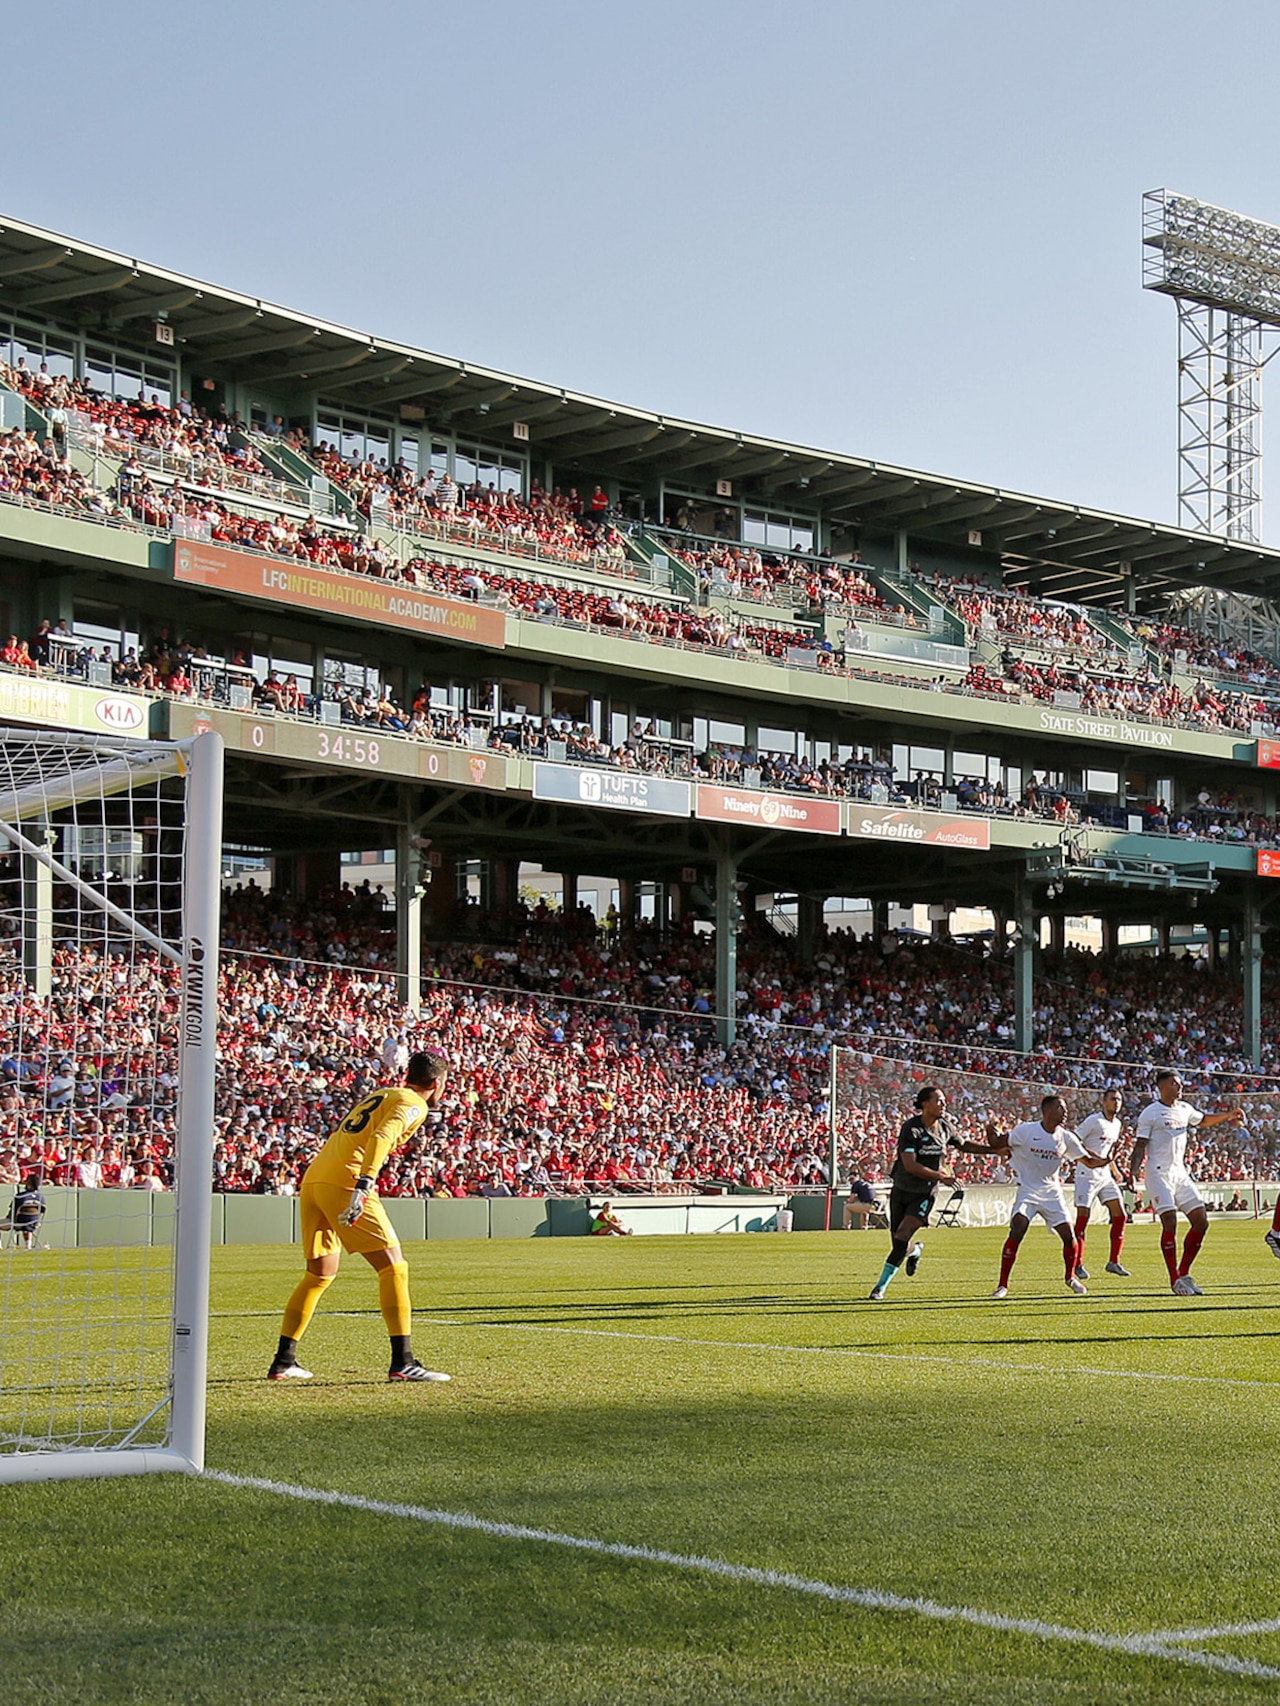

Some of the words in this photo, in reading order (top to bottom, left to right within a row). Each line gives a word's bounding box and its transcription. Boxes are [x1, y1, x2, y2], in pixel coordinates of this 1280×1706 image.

[160, 326, 170, 341] 13
[262, 568, 477, 631] LFCINTERNATIONALACADEMY.COM
[104, 703, 135, 724] KIA
[252, 726, 264, 748] 0
[1040, 712, 1074, 732] STATE
[1120, 723, 1173, 746] PAVILION
[317, 733, 380, 765] 34:58
[428, 754, 439, 775] 0
[601, 775, 648, 796] TUFTS
[602, 791, 628, 804] Health
[629, 796, 648, 807] Plan
[723, 797, 760, 816] Ninety
[780, 804, 808, 820] Nine
[860, 819, 924, 839] Safelite
[935, 831, 978, 845] AutoGlass
[1030, 1147, 1062, 1157] MARATH
[919, 1199, 929, 1211] 4
